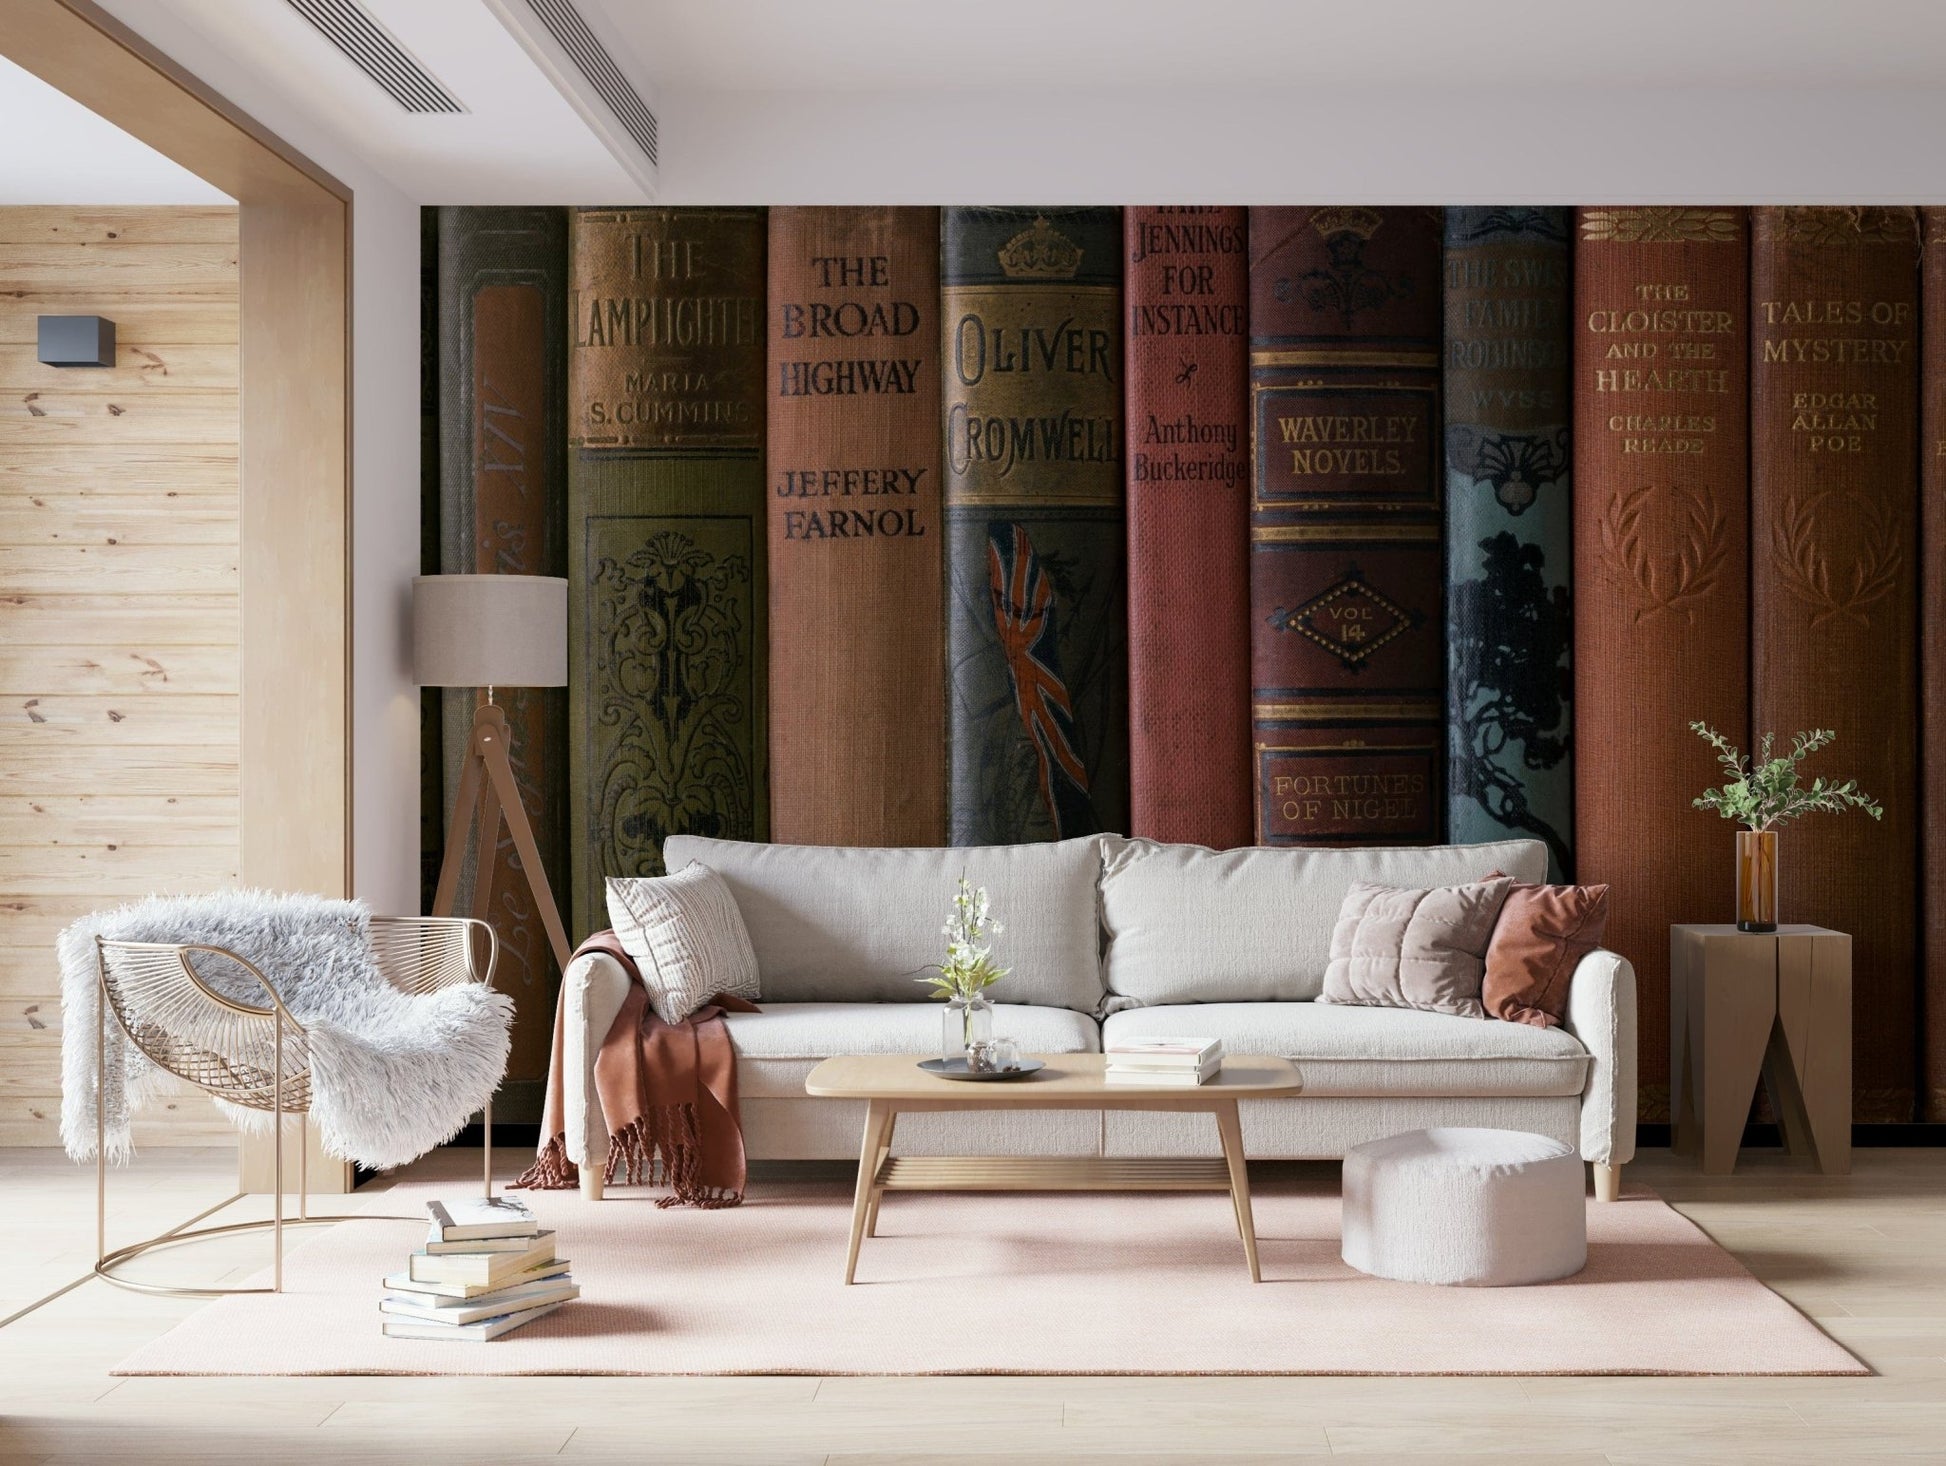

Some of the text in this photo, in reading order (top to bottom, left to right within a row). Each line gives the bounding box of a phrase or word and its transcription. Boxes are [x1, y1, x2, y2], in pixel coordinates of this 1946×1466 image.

[1133, 221, 1245, 263] JENNINGS
[624, 231, 708, 280] THE
[811, 256, 890, 288] THE
[1161, 265, 1215, 296] FOR
[1635, 284, 1689, 301] THE
[781, 301, 921, 339] BROAD
[1133, 304, 1246, 337] INSTANCE
[1587, 310, 1736, 334] CLOISTER
[1761, 301, 1910, 324] TALES OF
[1604, 342, 1716, 359] AND THE
[1762, 339, 1911, 364] MYSTERY
[625, 372, 710, 393] MARIA
[779, 359, 923, 397] HIGHWAY
[1595, 369, 1729, 393] HEARTH
[1793, 393, 1879, 410] EDGAR
[1143, 414, 1238, 453] Anthony
[1278, 415, 1418, 443] WAVERLEY
[1609, 415, 1716, 432] CHARLES
[1792, 414, 1878, 431] ALLAN
[1624, 438, 1705, 454] READE
[1809, 435, 1863, 452] POE
[1135, 452, 1247, 488] Buckeridge
[776, 467, 928, 498] JEFFERY
[783, 508, 926, 540] FARNOL
[1341, 624, 1366, 642] 14
[1273, 774, 1425, 797] FORTUNES
[1282, 799, 1418, 820] OF NIGEL
